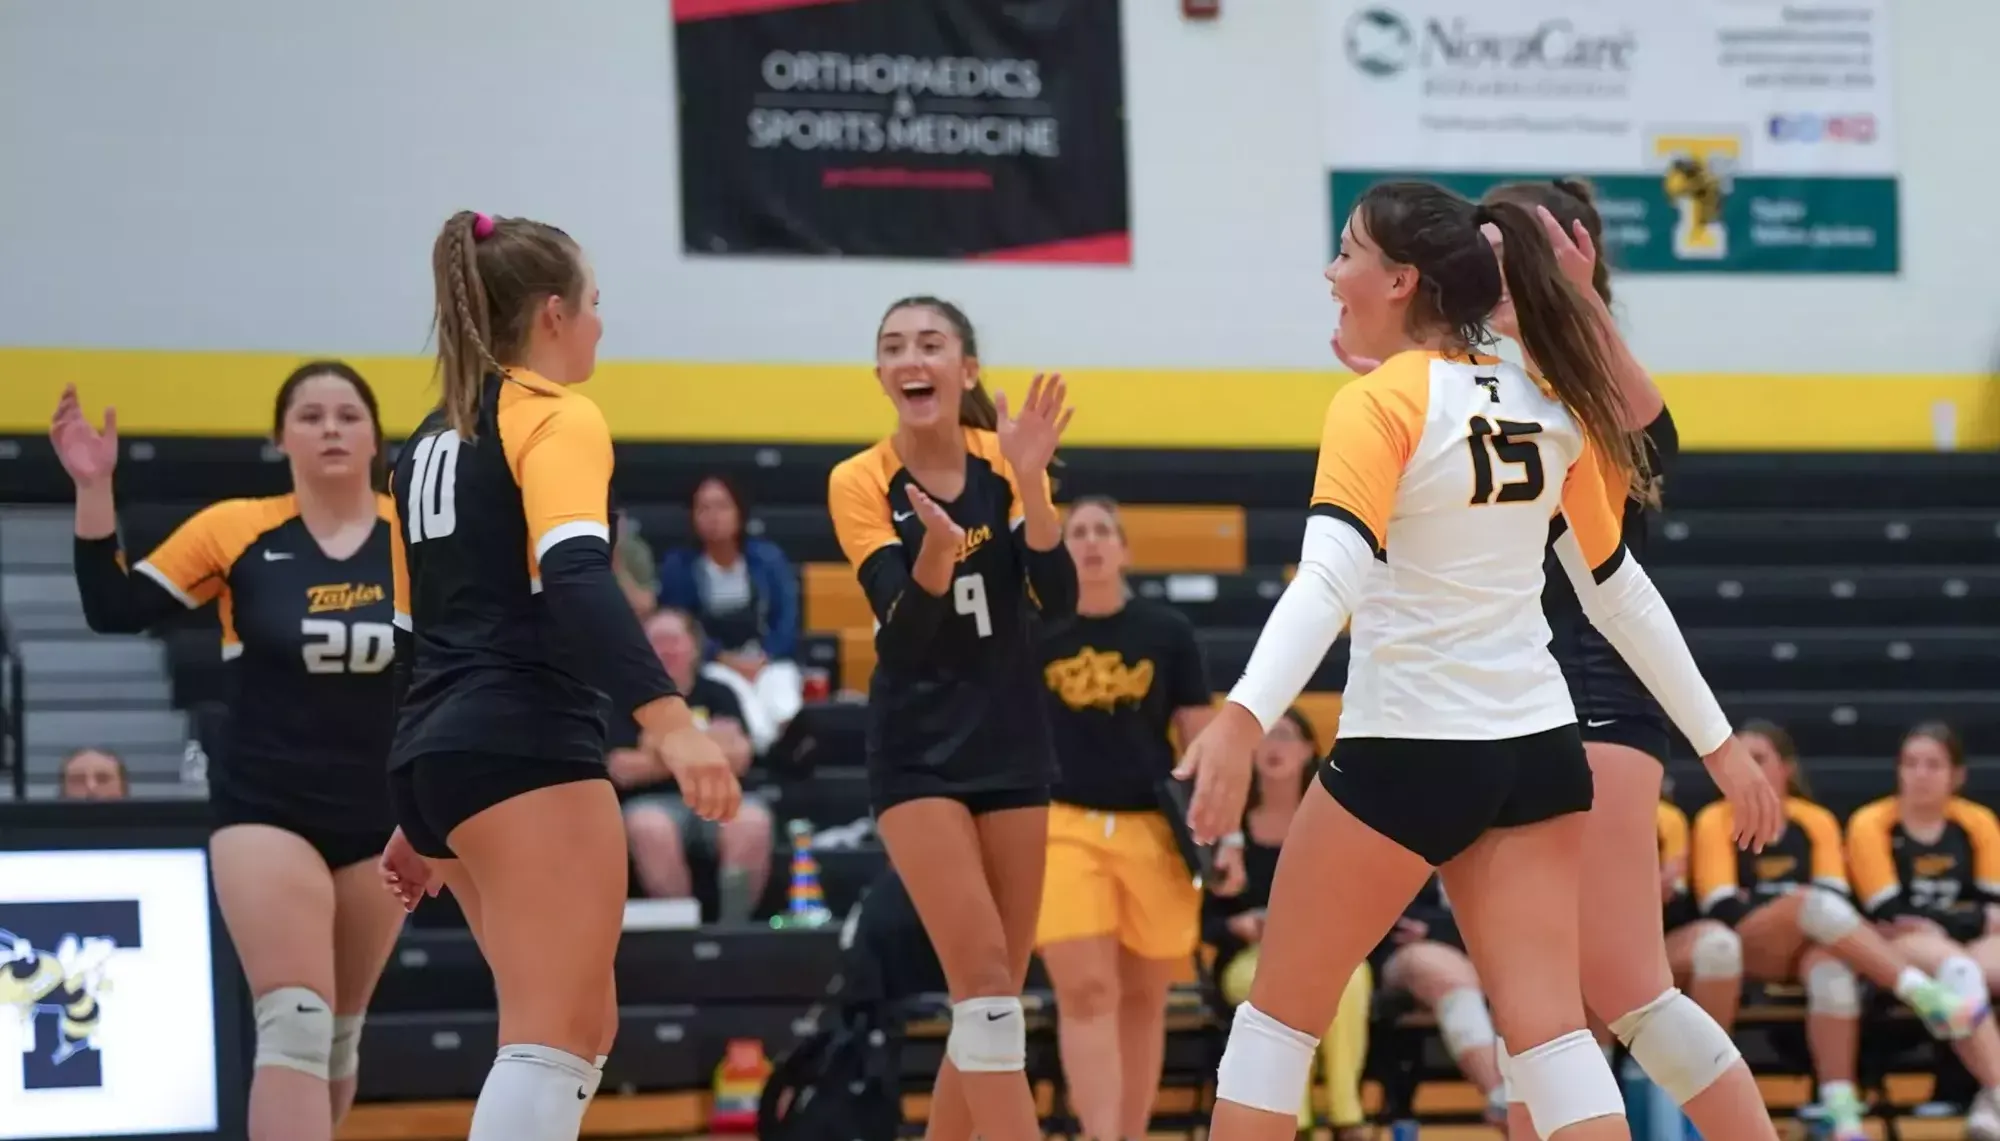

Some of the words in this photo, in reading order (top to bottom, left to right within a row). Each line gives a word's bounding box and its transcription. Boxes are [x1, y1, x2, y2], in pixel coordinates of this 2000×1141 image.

[761, 49, 1042, 99] ORTHOPAEDICS
[747, 108, 886, 153] SPORTS
[887, 115, 1060, 157] MEDICINE
[407, 428, 461, 545] 10
[1467, 415, 1545, 505] 15
[306, 582, 386, 614] Taylor
[953, 571, 993, 639] 9
[300, 617, 396, 674] 20
